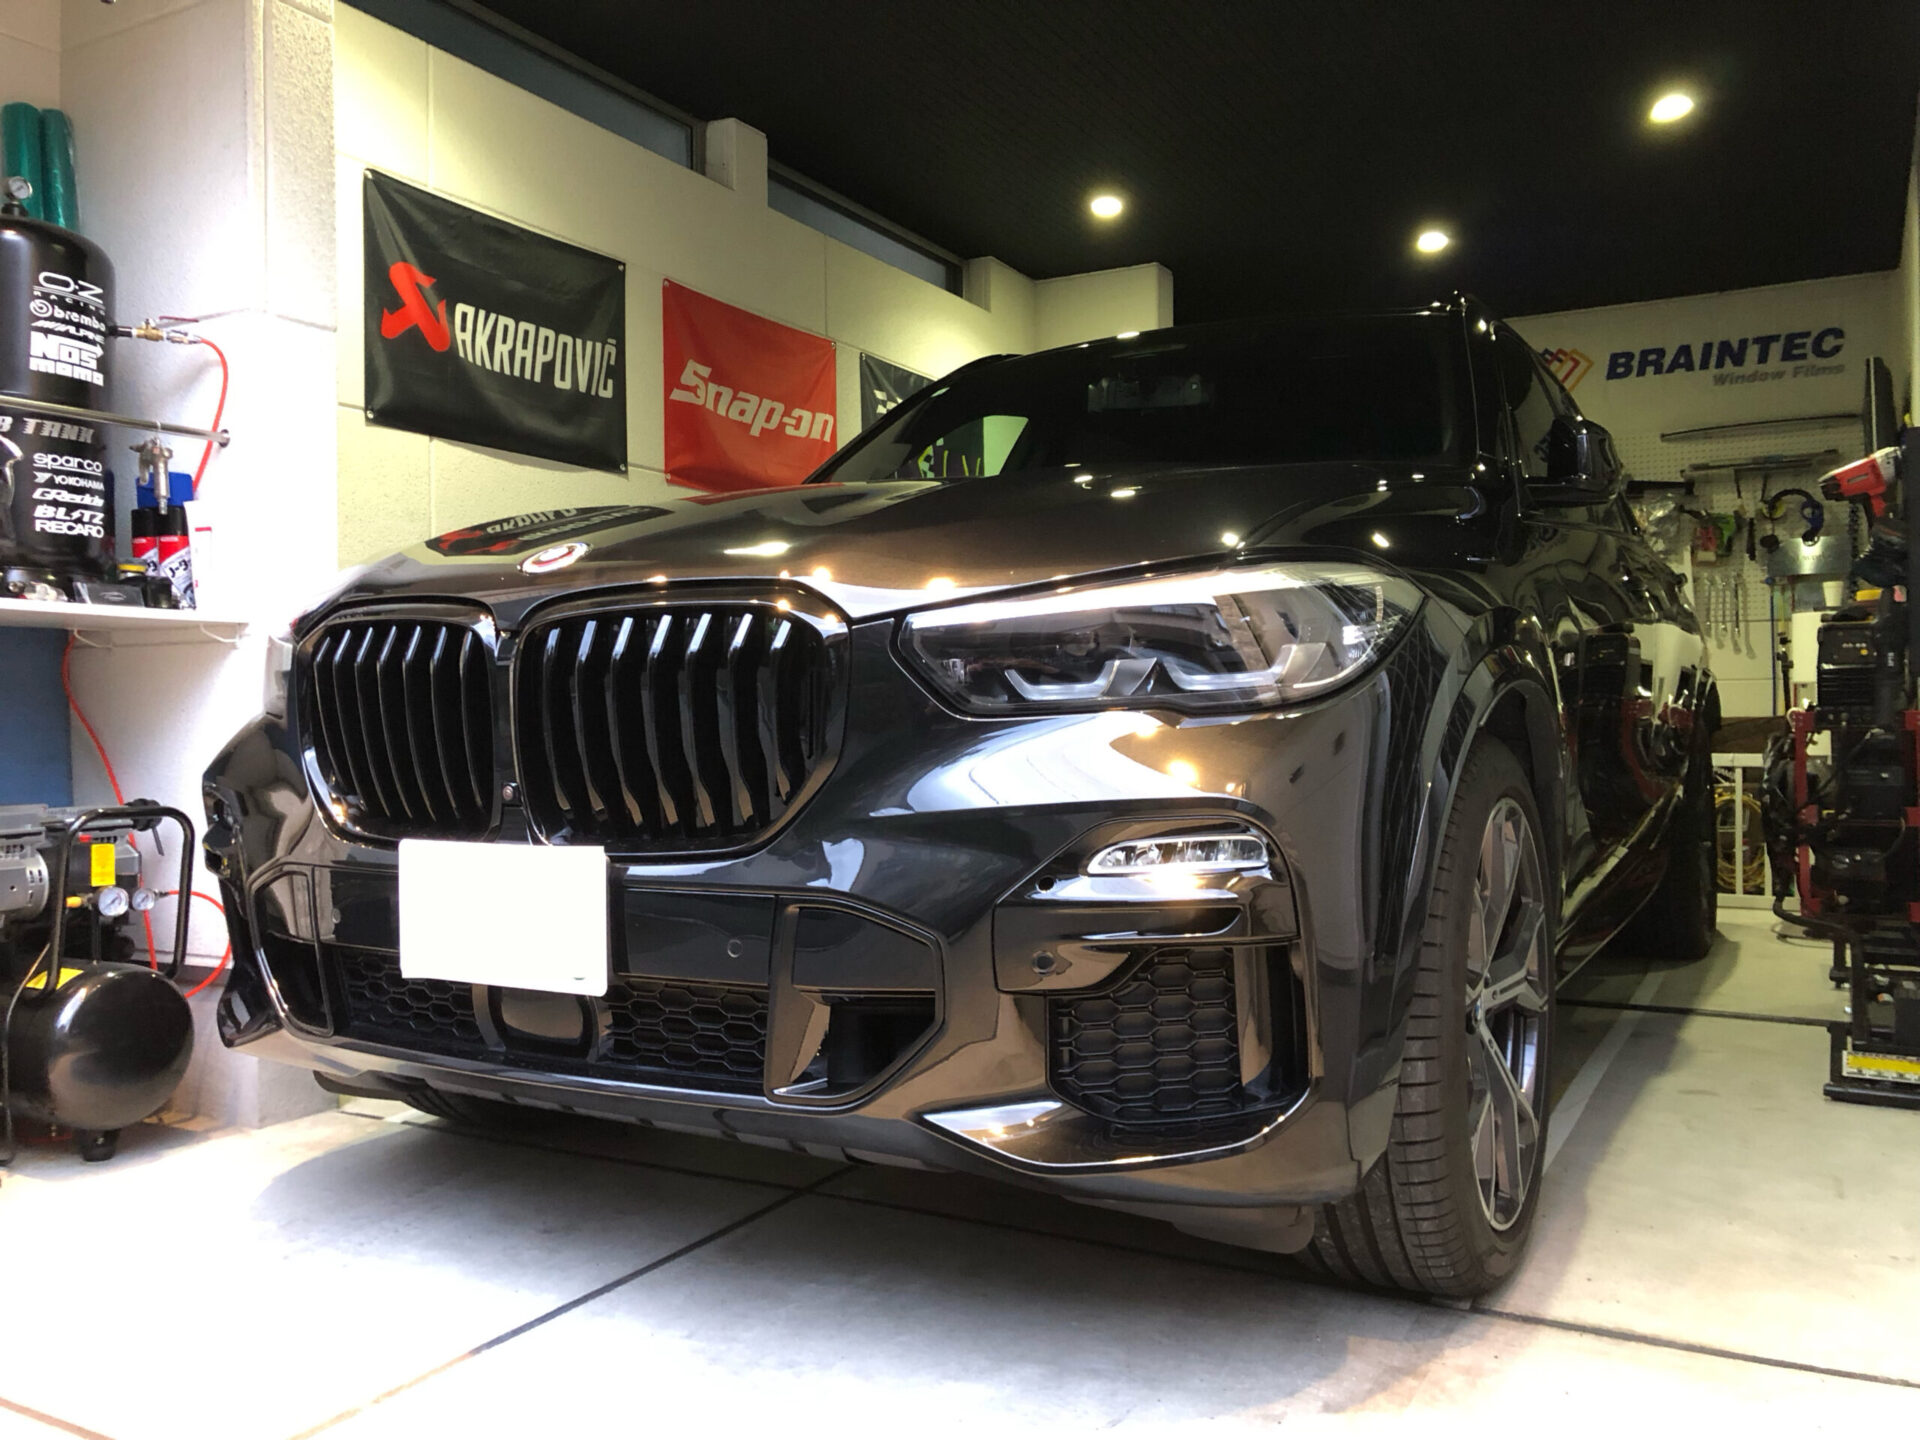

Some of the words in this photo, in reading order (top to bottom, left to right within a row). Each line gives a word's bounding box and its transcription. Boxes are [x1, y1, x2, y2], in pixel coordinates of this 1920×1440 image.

[1606, 327, 1845, 380] BRAINTEC
[1712, 370, 1786, 386] Window
[1792, 364, 1845, 379] Films
[669, 358, 834, 443] Snap-on
[32, 452, 103, 473] sparco
[52, 474, 105, 491] YOKOHAMA
[33, 504, 104, 525] BLITZ
[35, 519, 104, 539] RECARO
